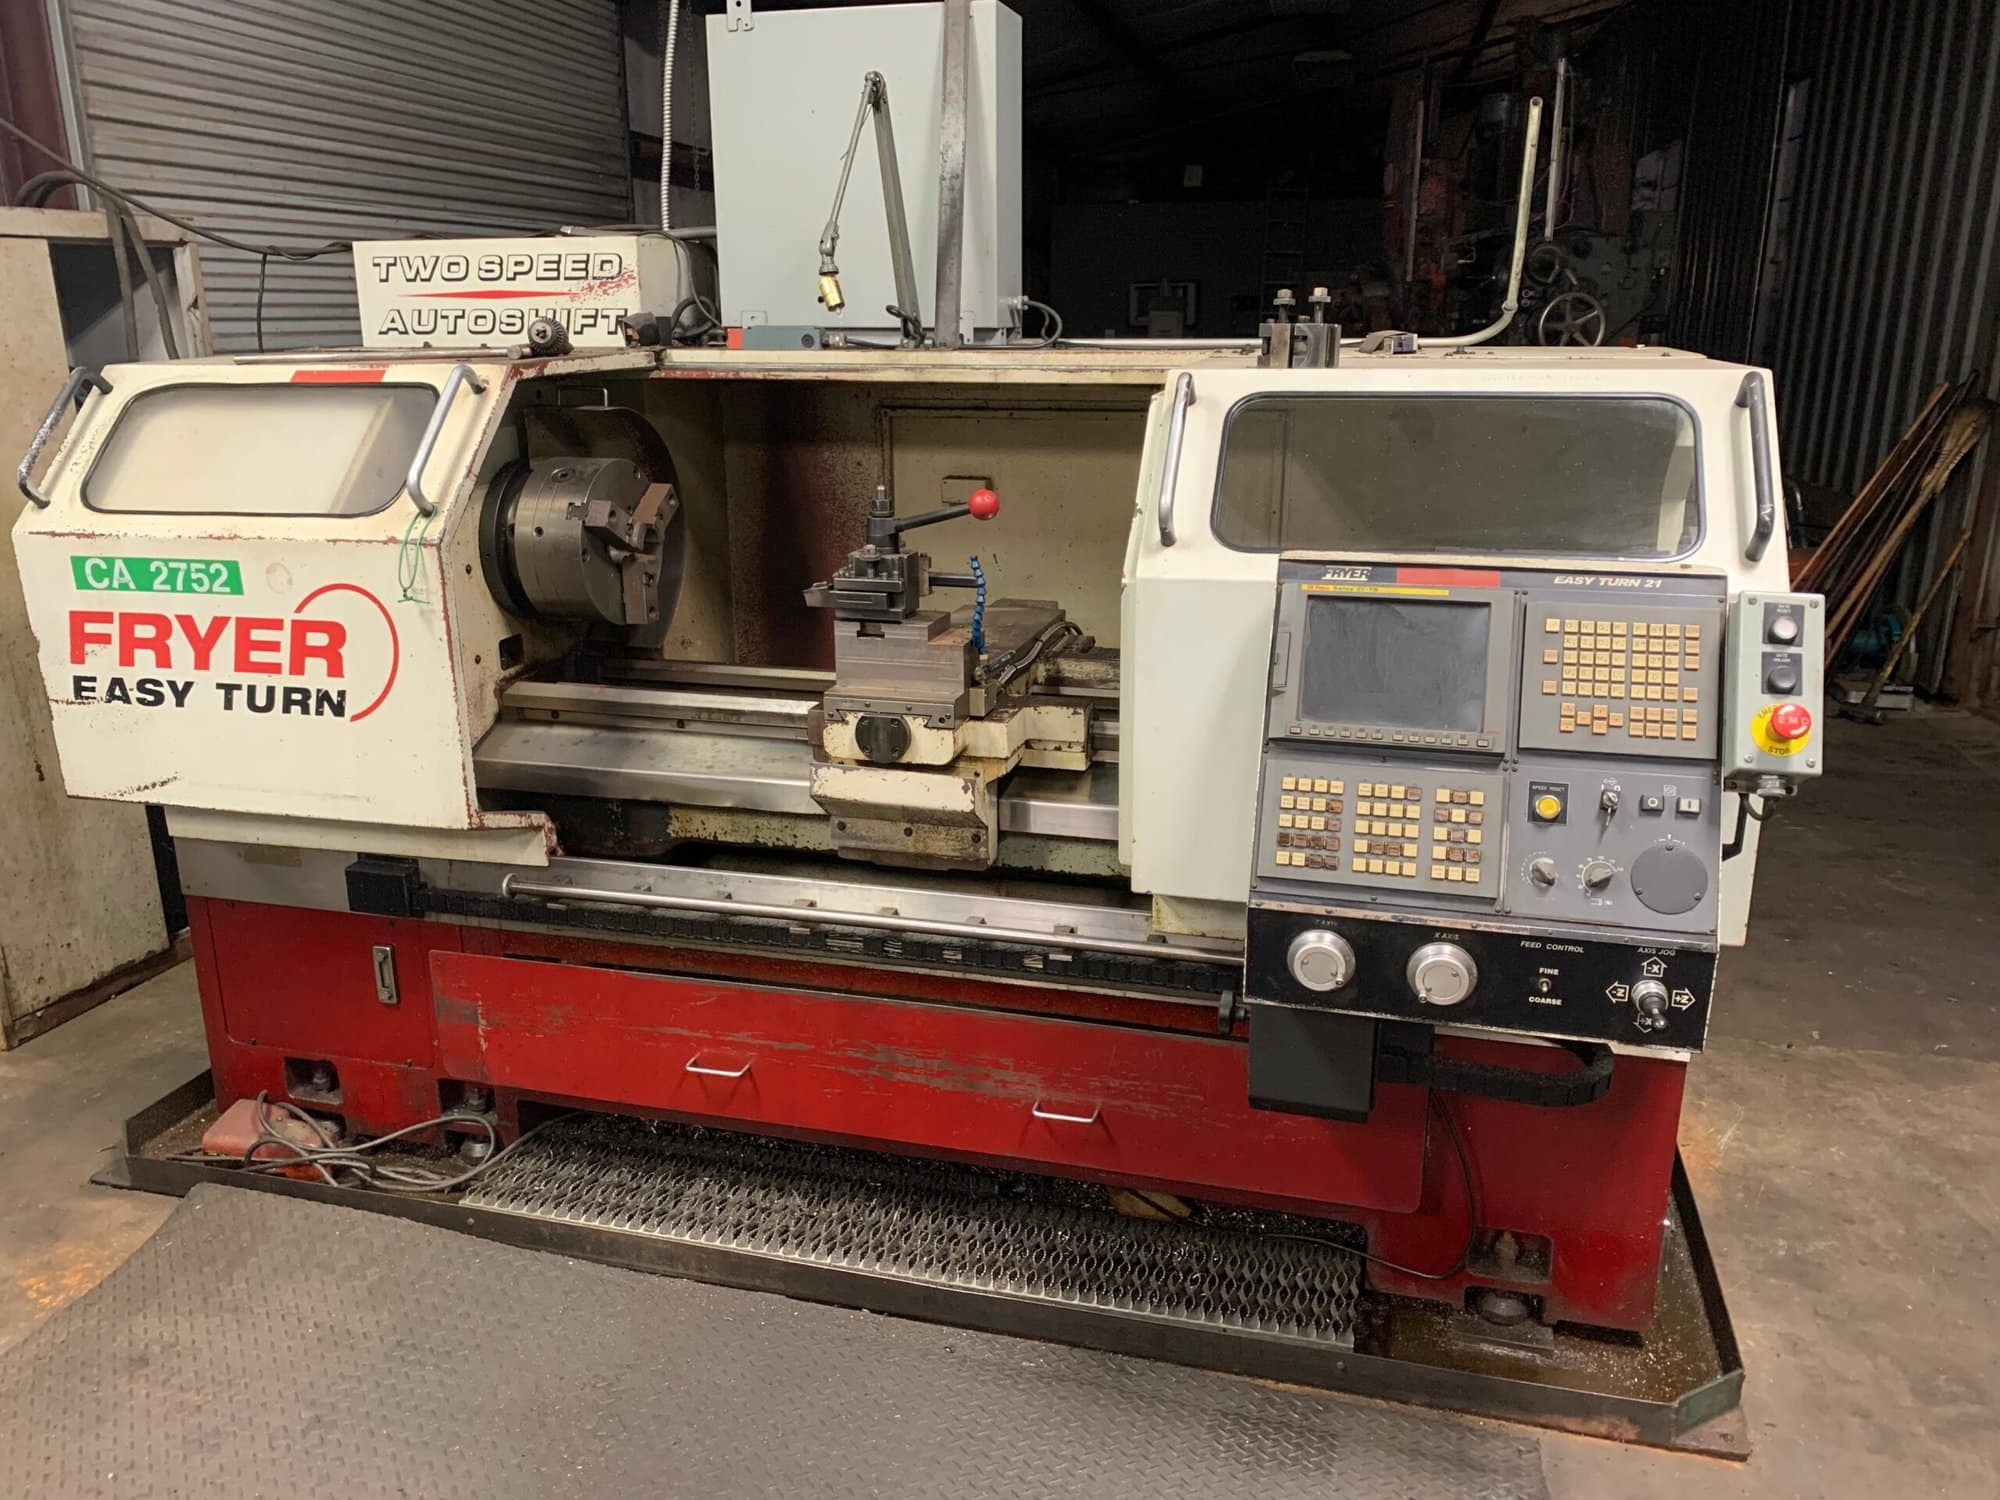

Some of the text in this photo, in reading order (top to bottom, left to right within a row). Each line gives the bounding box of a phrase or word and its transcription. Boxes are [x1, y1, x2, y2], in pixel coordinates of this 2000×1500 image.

[372, 253, 623, 282] TWO SPEED
[84, 558, 231, 593] CA 2752
[1322, 565, 1372, 581] FRYER
[1554, 575, 1662, 589] EASY TURN 21
[69, 610, 347, 678] FRYER
[73, 675, 347, 717] EASY TURN
[1520, 940, 1584, 953] FEED CONTROL
[1637, 946, 1676, 957] AXIS JOG
[1539, 967, 1559, 976] FINE
[1528, 996, 1563, 1006] COARSE
